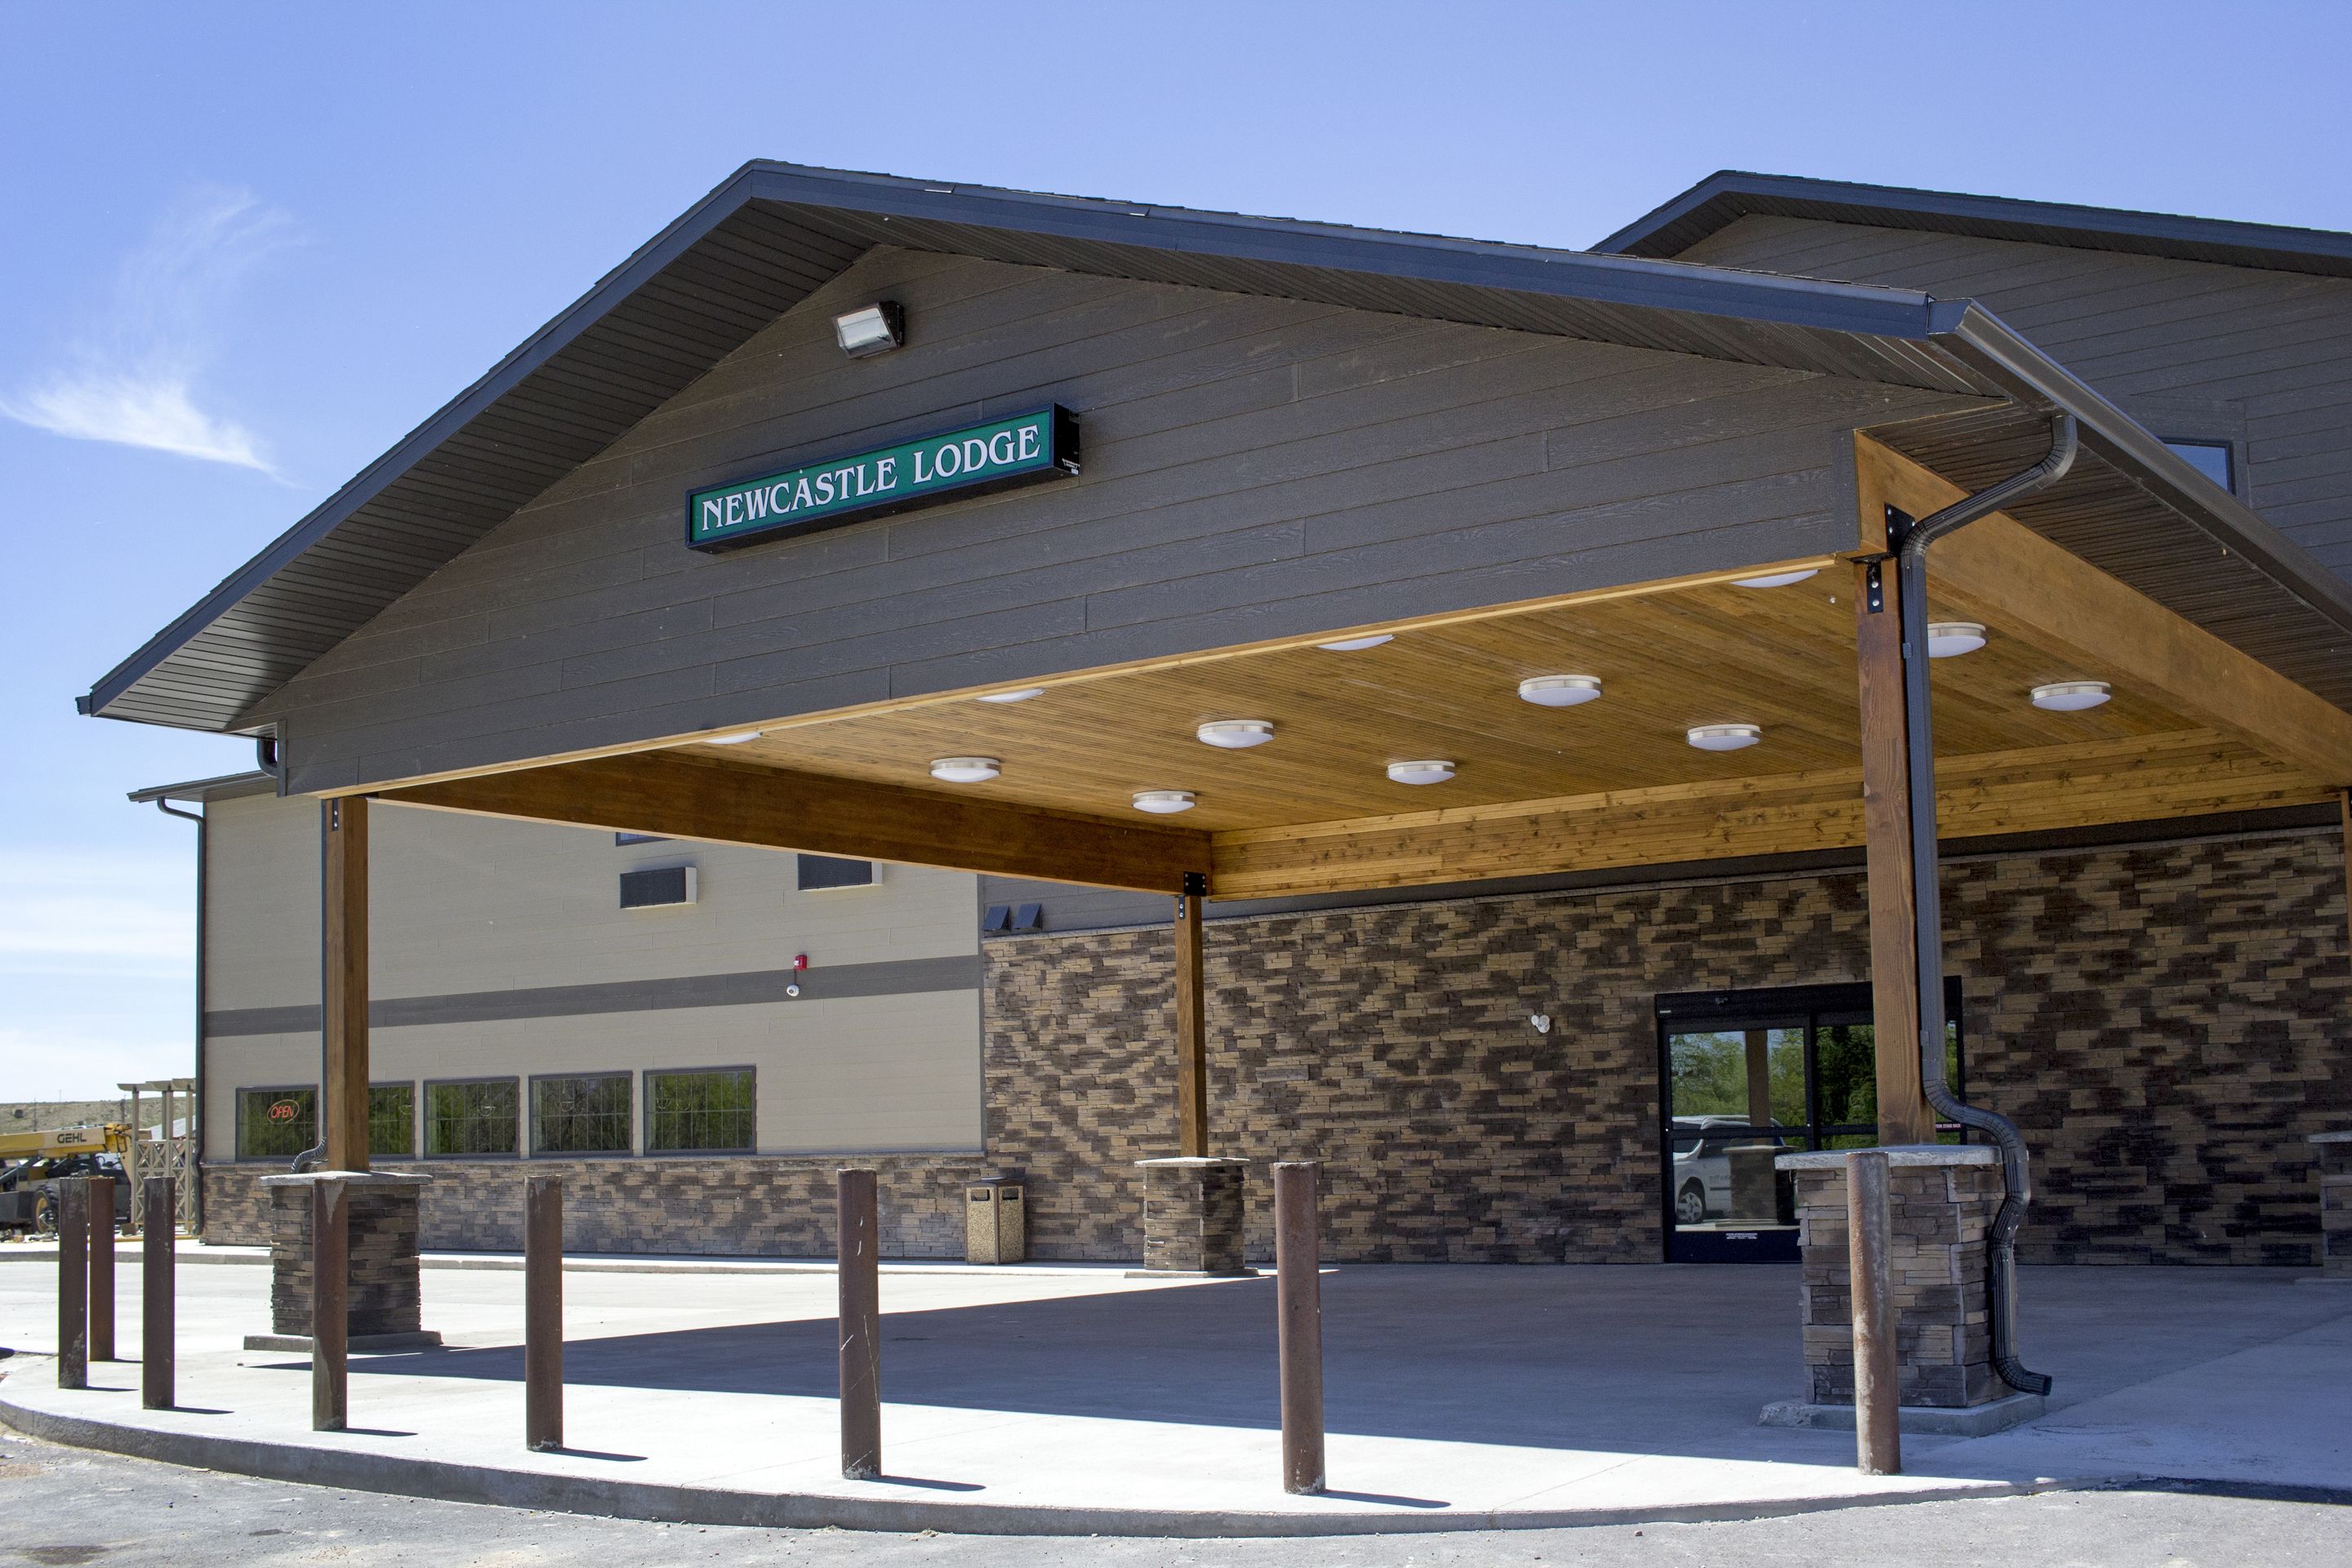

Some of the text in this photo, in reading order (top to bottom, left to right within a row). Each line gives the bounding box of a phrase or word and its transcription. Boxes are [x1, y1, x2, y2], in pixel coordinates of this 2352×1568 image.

[701, 424, 1041, 532] NEWCASTLE LODGE
[270, 1105, 293, 1119] OPEN
[57, 1132, 87, 1143] GEHL
